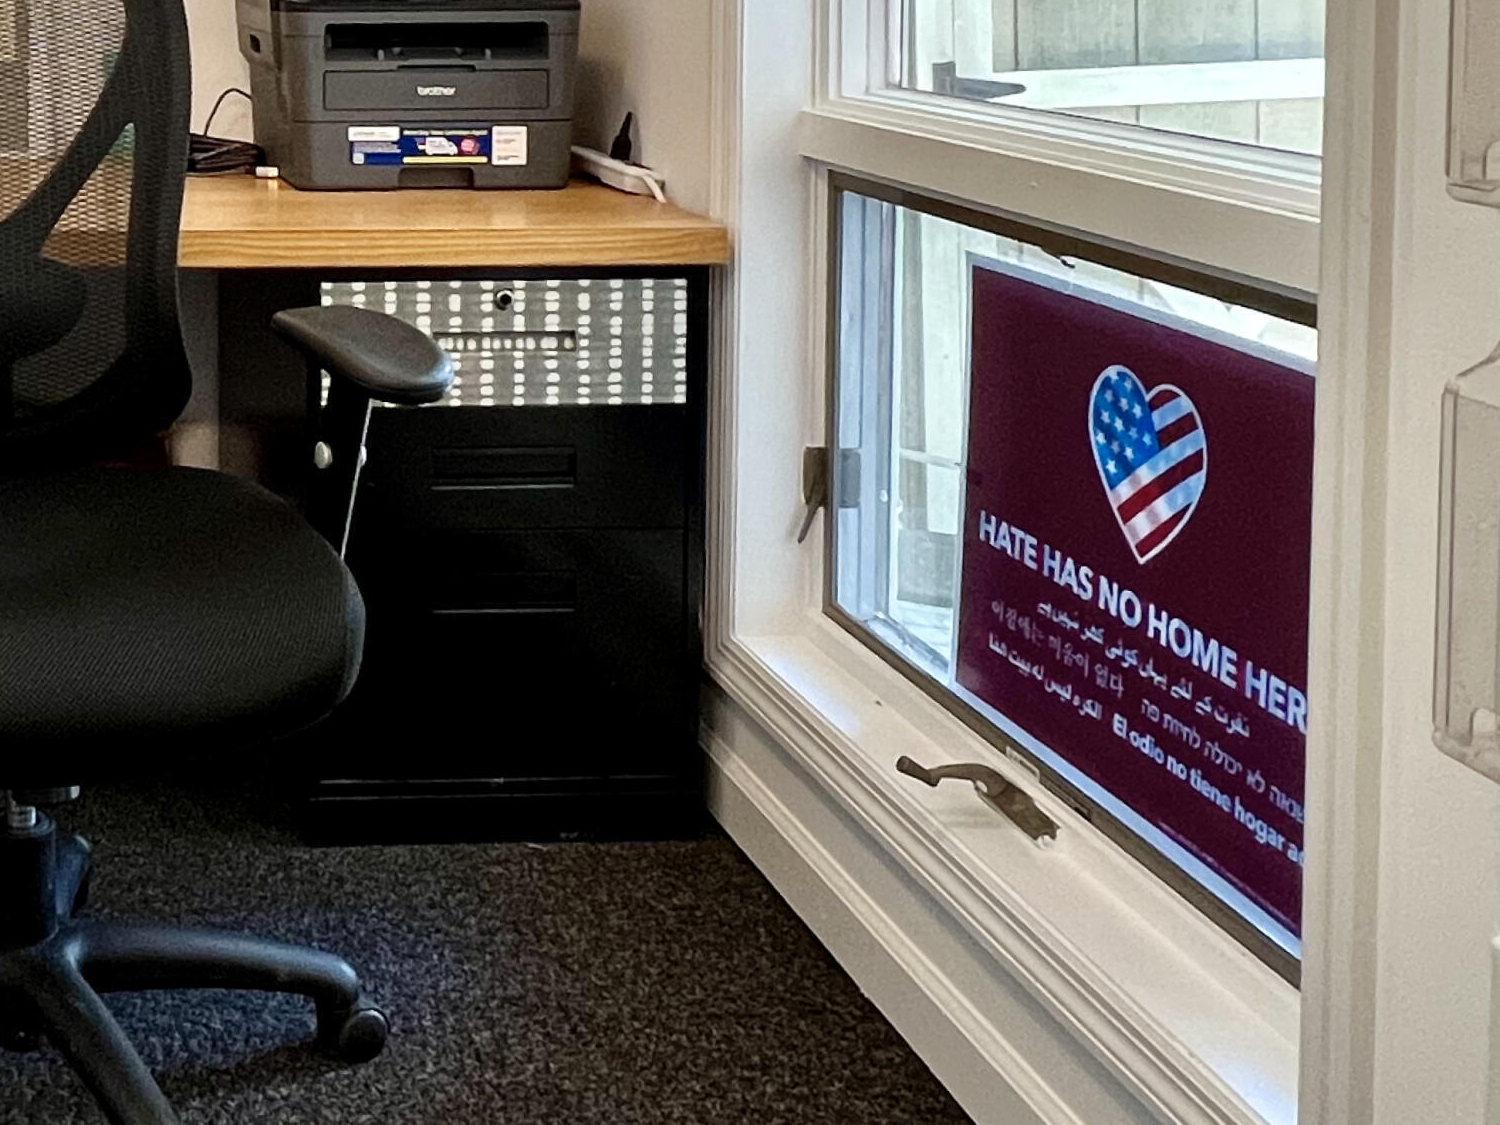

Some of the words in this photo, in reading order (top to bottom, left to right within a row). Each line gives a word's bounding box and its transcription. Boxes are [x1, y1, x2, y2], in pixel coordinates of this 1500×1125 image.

[979, 510, 1038, 570] HATE
[1043, 544, 1094, 600] HAS
[1098, 575, 1142, 628] NO
[1147, 603, 1238, 689] HOME
[1245, 660, 1307, 736] HER
[1112, 713, 1128, 739] El
[1129, 730, 1165, 765] odio
[1166, 755, 1187, 781] no
[1189, 768, 1233, 813] tiene
[1233, 795, 1286, 851] hogar
